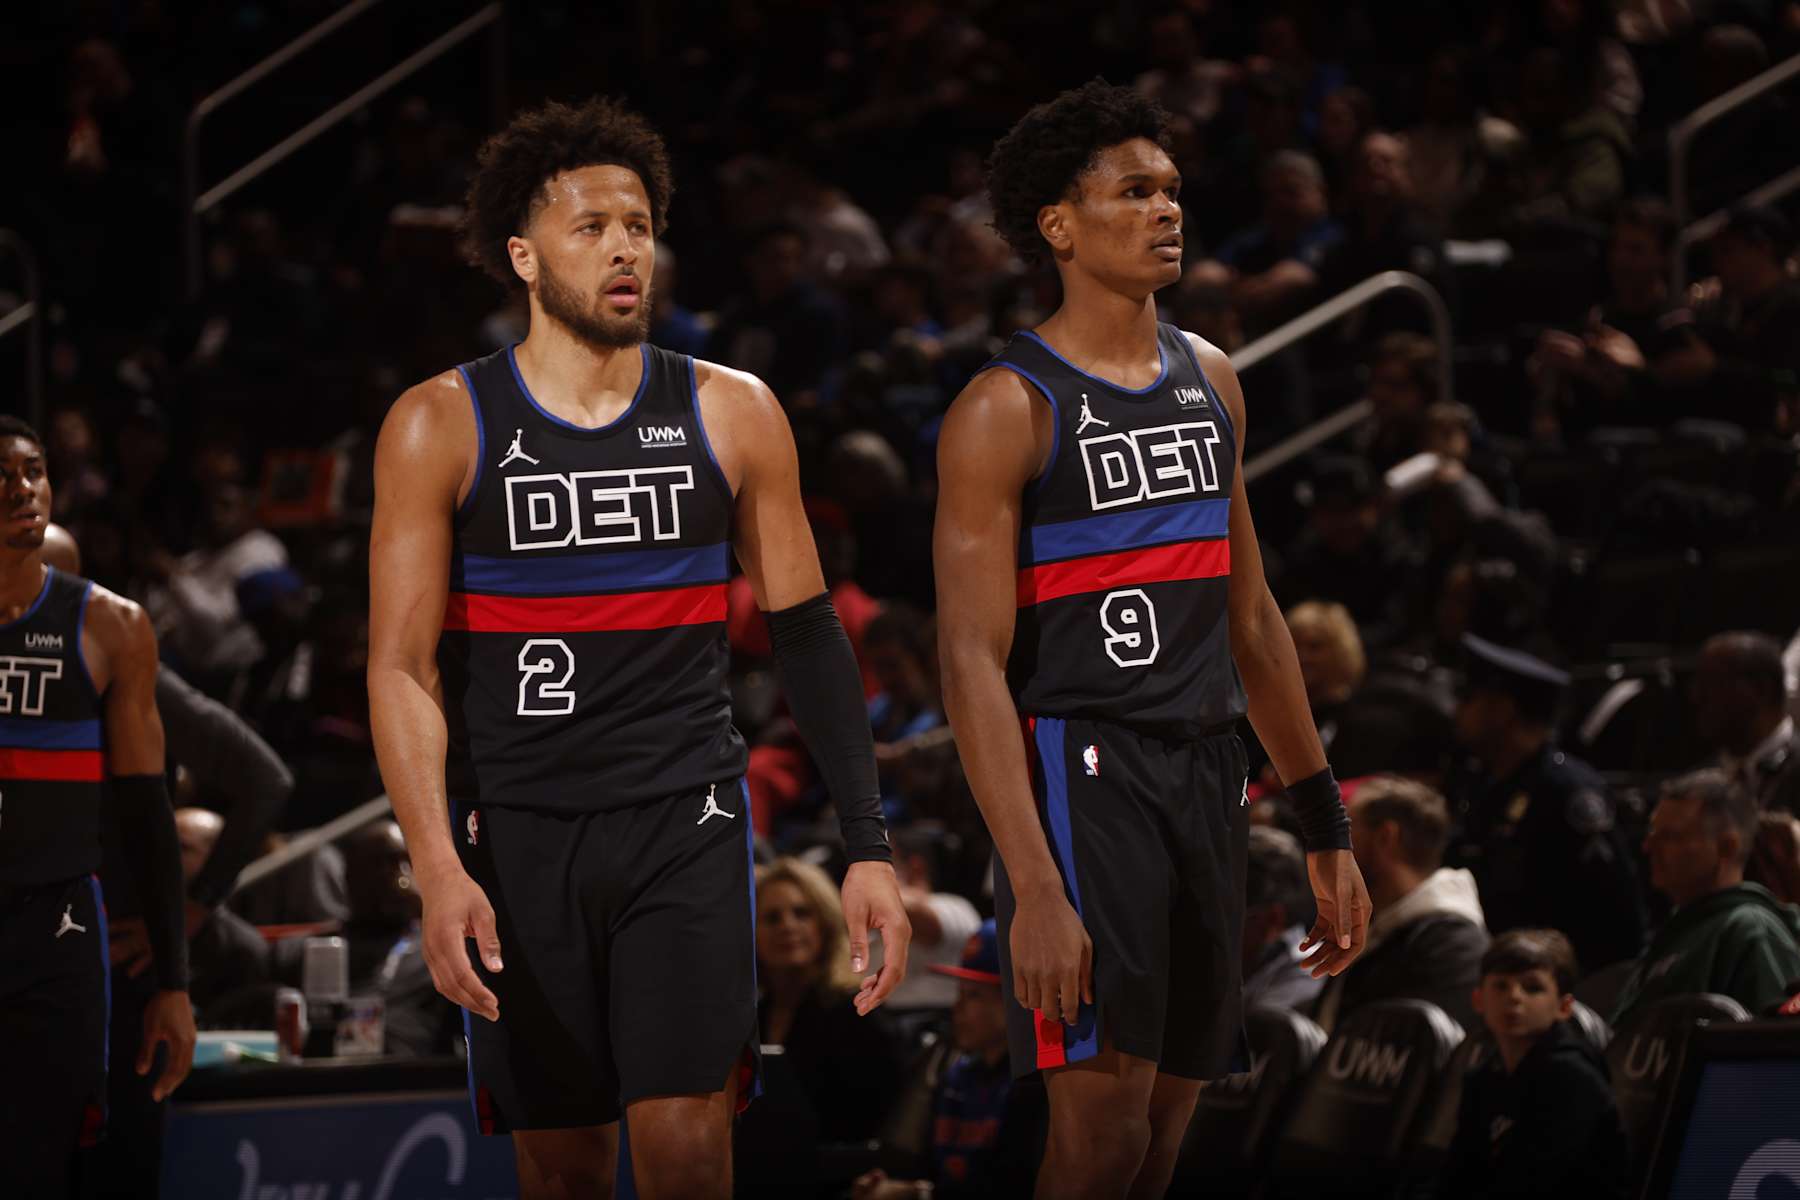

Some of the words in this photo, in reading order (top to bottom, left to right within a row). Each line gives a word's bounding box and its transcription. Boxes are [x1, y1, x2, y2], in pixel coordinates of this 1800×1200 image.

[1174, 388, 1207, 405] UWM
[638, 426, 686, 442] UWM
[1078, 420, 1221, 511] DET
[504, 465, 695, 551] DET
[25, 632, 63, 648] UWM
[1099, 588, 1160, 667] 9
[516, 638, 576, 716] 2
[1327, 1034, 1414, 1086] UWM
